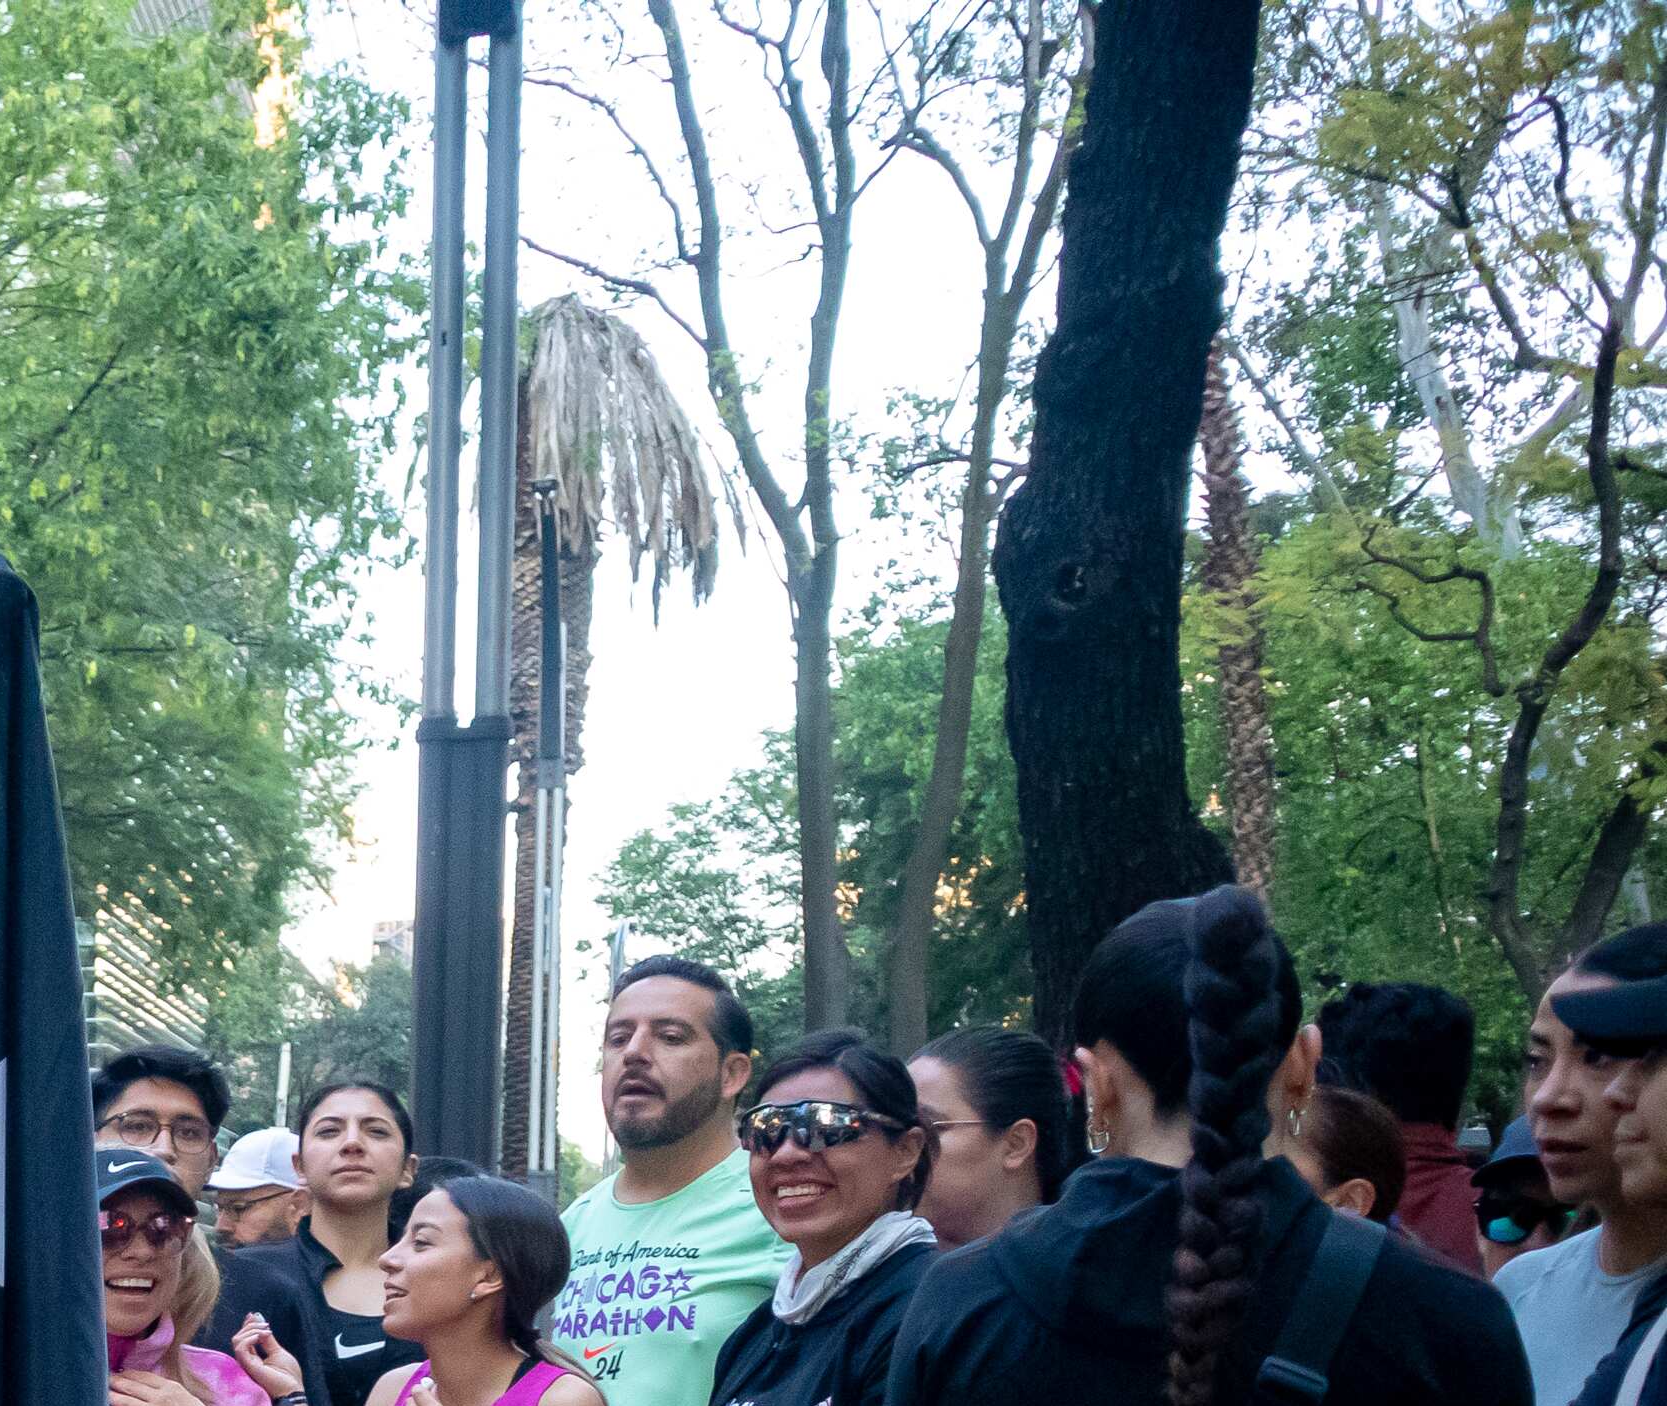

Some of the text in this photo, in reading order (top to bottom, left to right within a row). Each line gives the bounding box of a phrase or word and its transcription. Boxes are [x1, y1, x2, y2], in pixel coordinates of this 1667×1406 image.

[604, 1243, 623, 1268] of
[622, 1240, 700, 1263] America
[595, 1351, 624, 1380] 24
